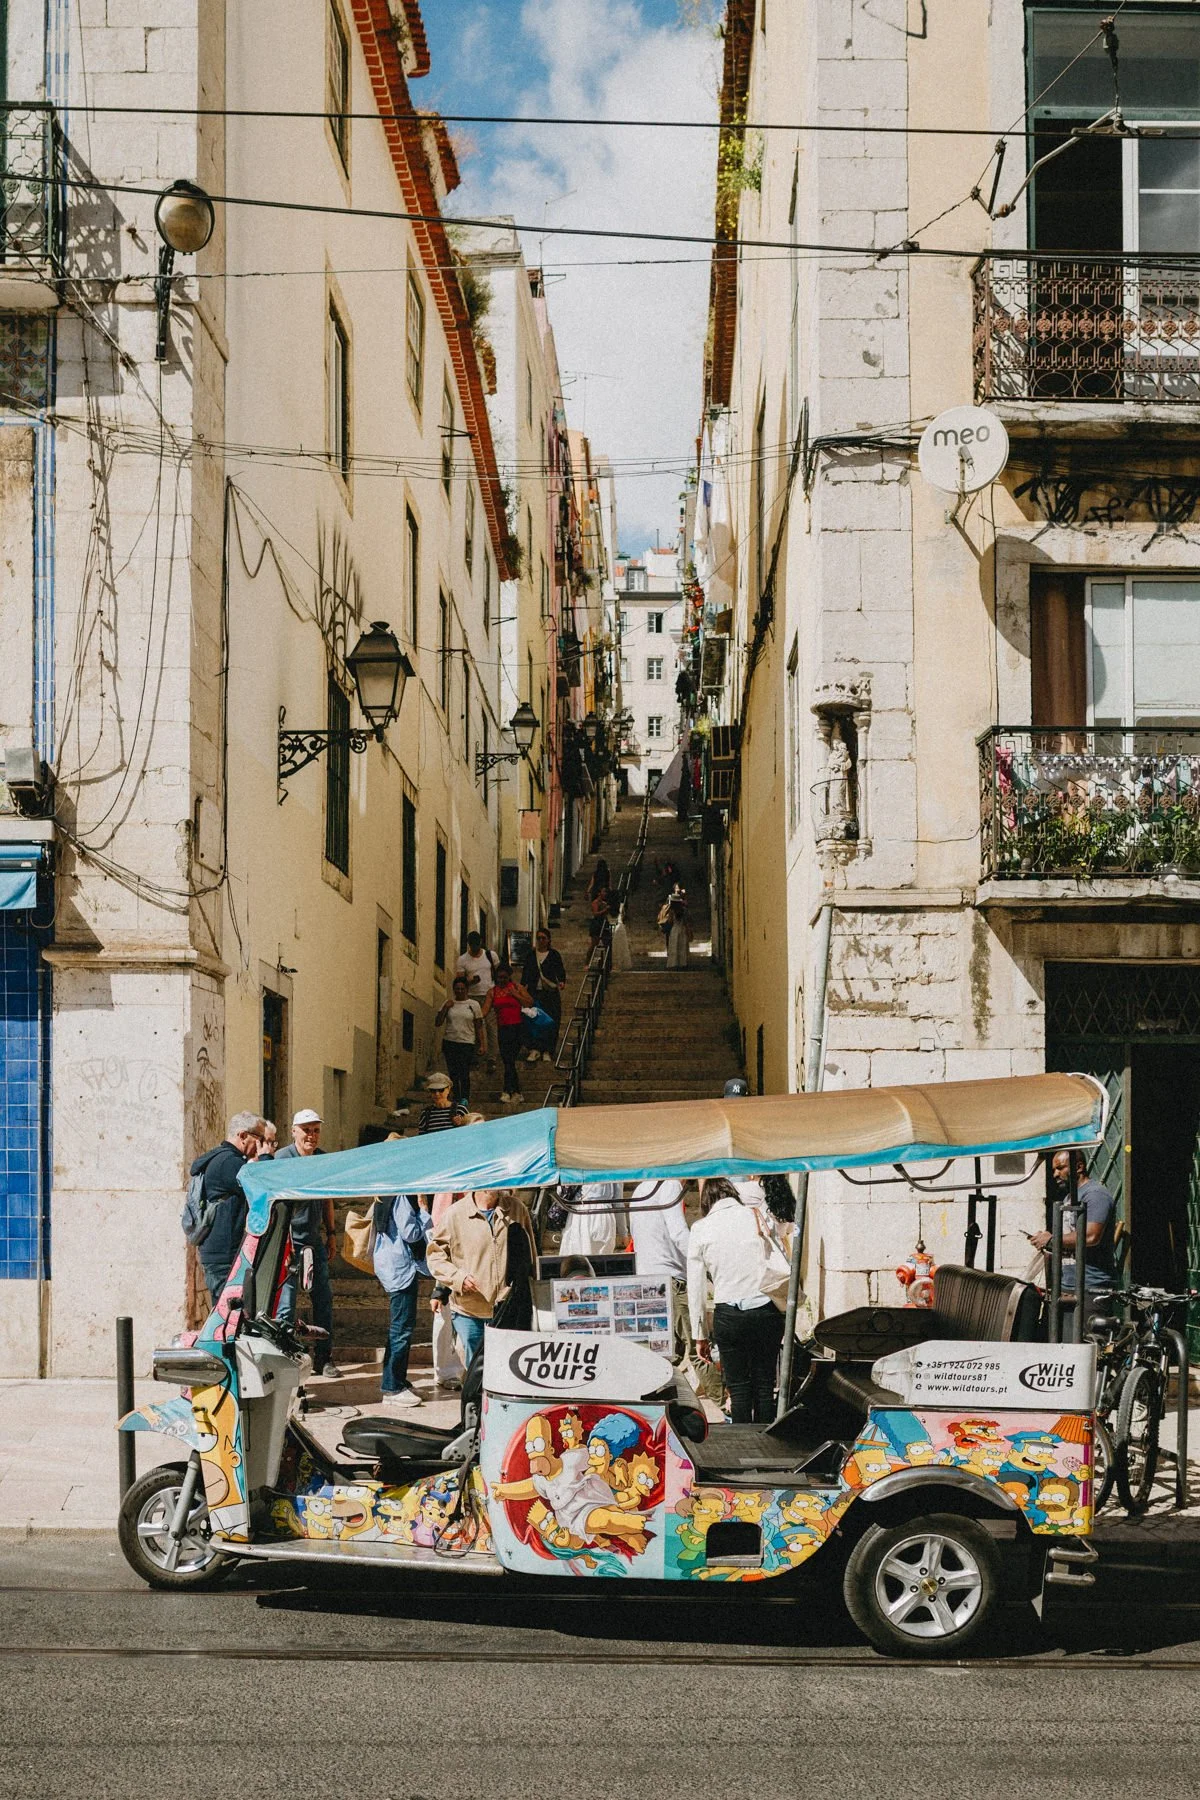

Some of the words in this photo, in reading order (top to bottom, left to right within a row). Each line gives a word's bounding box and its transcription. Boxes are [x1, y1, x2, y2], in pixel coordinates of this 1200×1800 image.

[933, 425, 990, 447] meo
[539, 1341, 600, 1364] Wild
[523, 1357, 597, 1381] Tours
[966, 1362, 983, 1371] 072
[984, 1362, 1001, 1371] 985
[1038, 1363, 1075, 1377] Wild
[933, 1372, 988, 1382] wildtours81
[1028, 1373, 1074, 1388] Tours
[927, 1384, 1008, 1395] www.wildtours.pt
